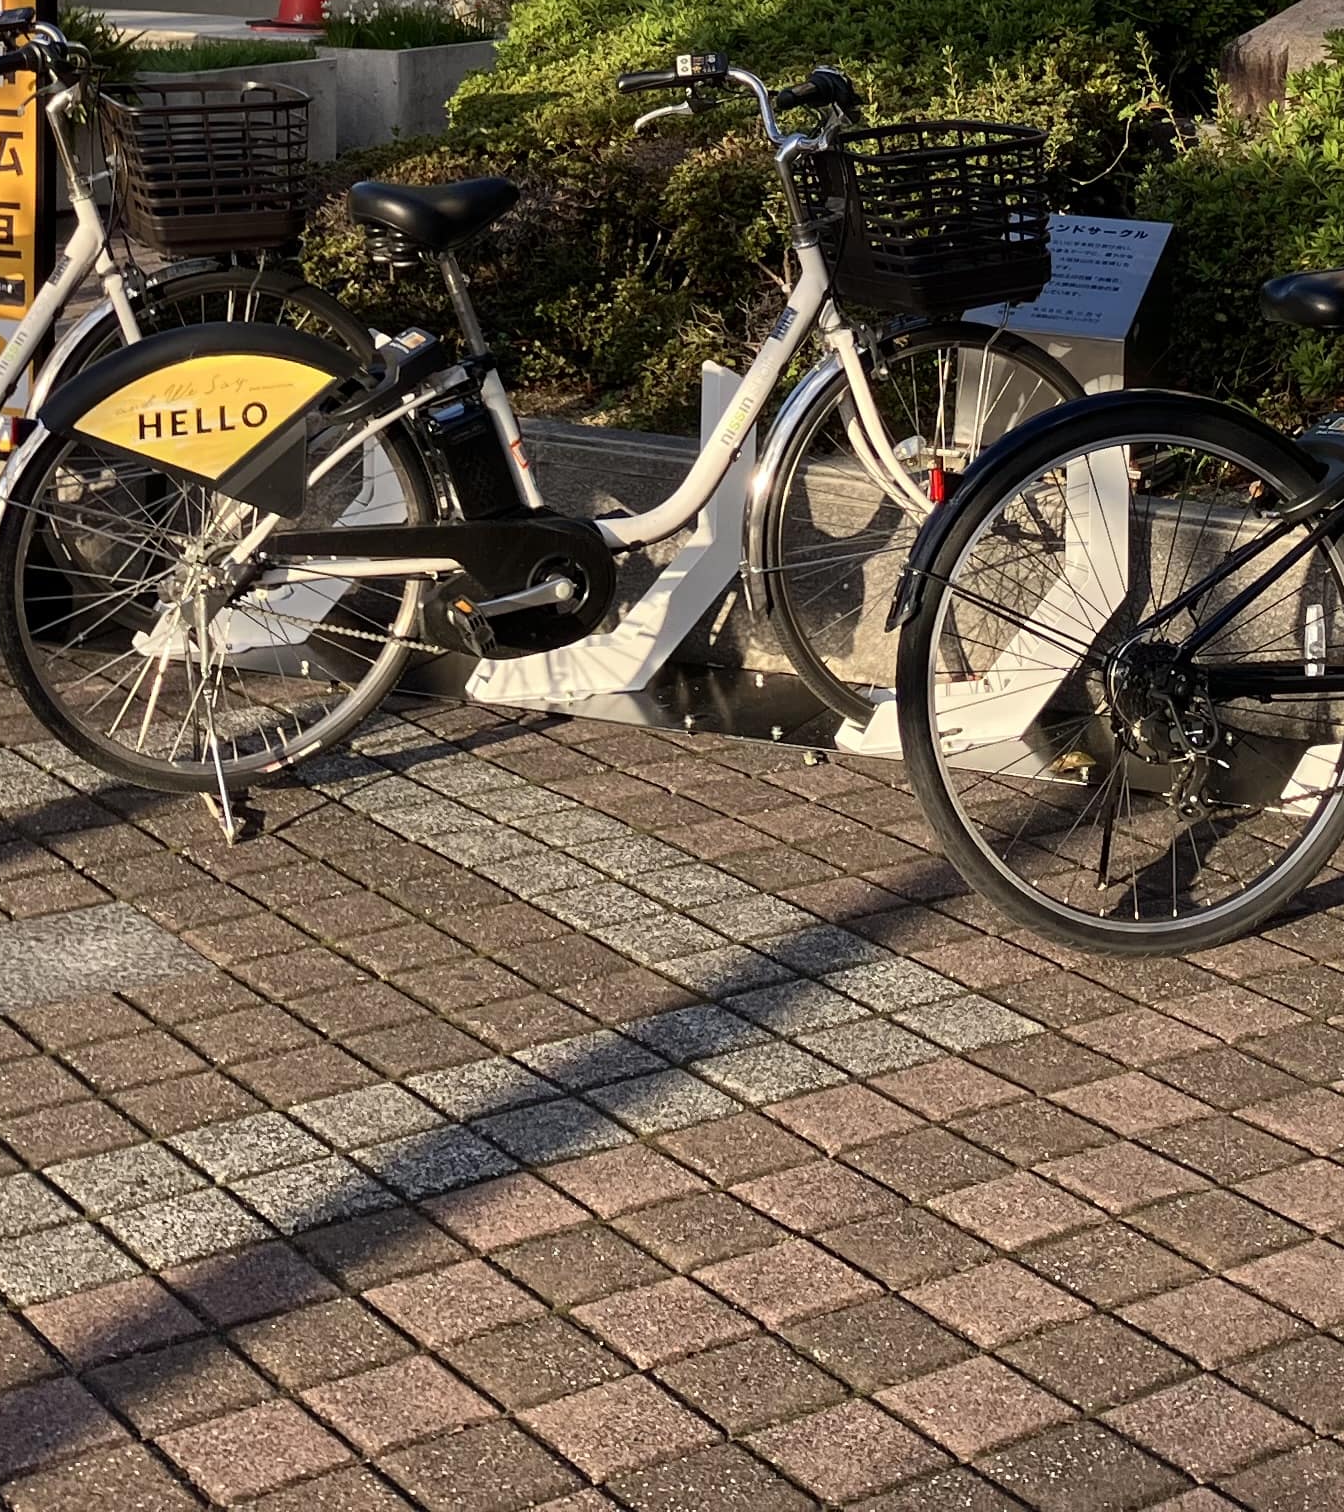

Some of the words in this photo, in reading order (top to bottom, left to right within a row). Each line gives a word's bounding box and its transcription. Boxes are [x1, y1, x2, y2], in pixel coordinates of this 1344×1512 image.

[204, 374, 248, 395] Say
[138, 401, 268, 440] HELLO
[720, 396, 754, 446] nissin
